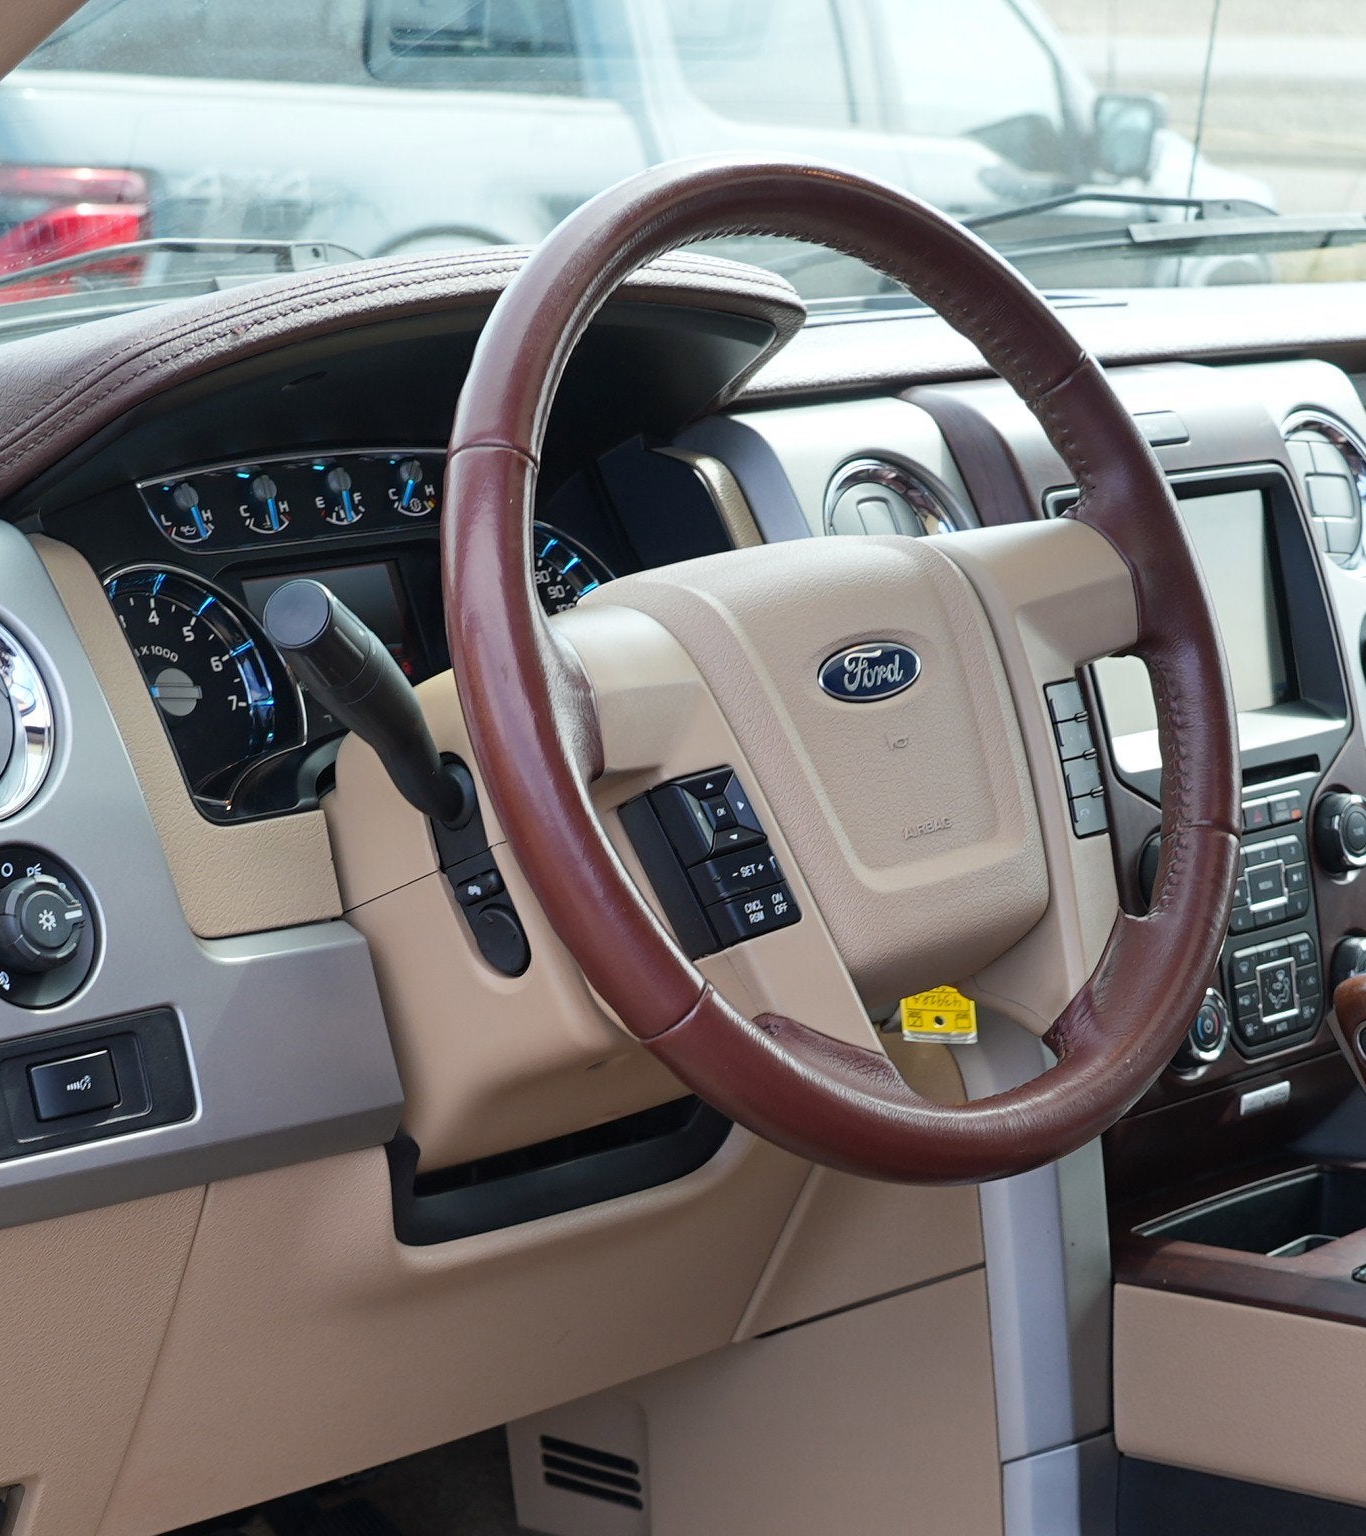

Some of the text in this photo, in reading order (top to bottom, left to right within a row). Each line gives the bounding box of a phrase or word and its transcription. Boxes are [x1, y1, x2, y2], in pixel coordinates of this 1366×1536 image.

[314, 491, 363, 509] E F
[160, 508, 213, 526] L H
[239, 500, 290, 518] C H
[547, 584, 566, 600] 90
[147, 610, 161, 627] 4
[181, 626, 195, 643] 5
[209, 656, 224, 673] 6
[843, 649, 905, 692] Ford
[227, 695, 239, 712] 7
[771, 891, 785, 904] ON
[774, 902, 789, 916] OFF
